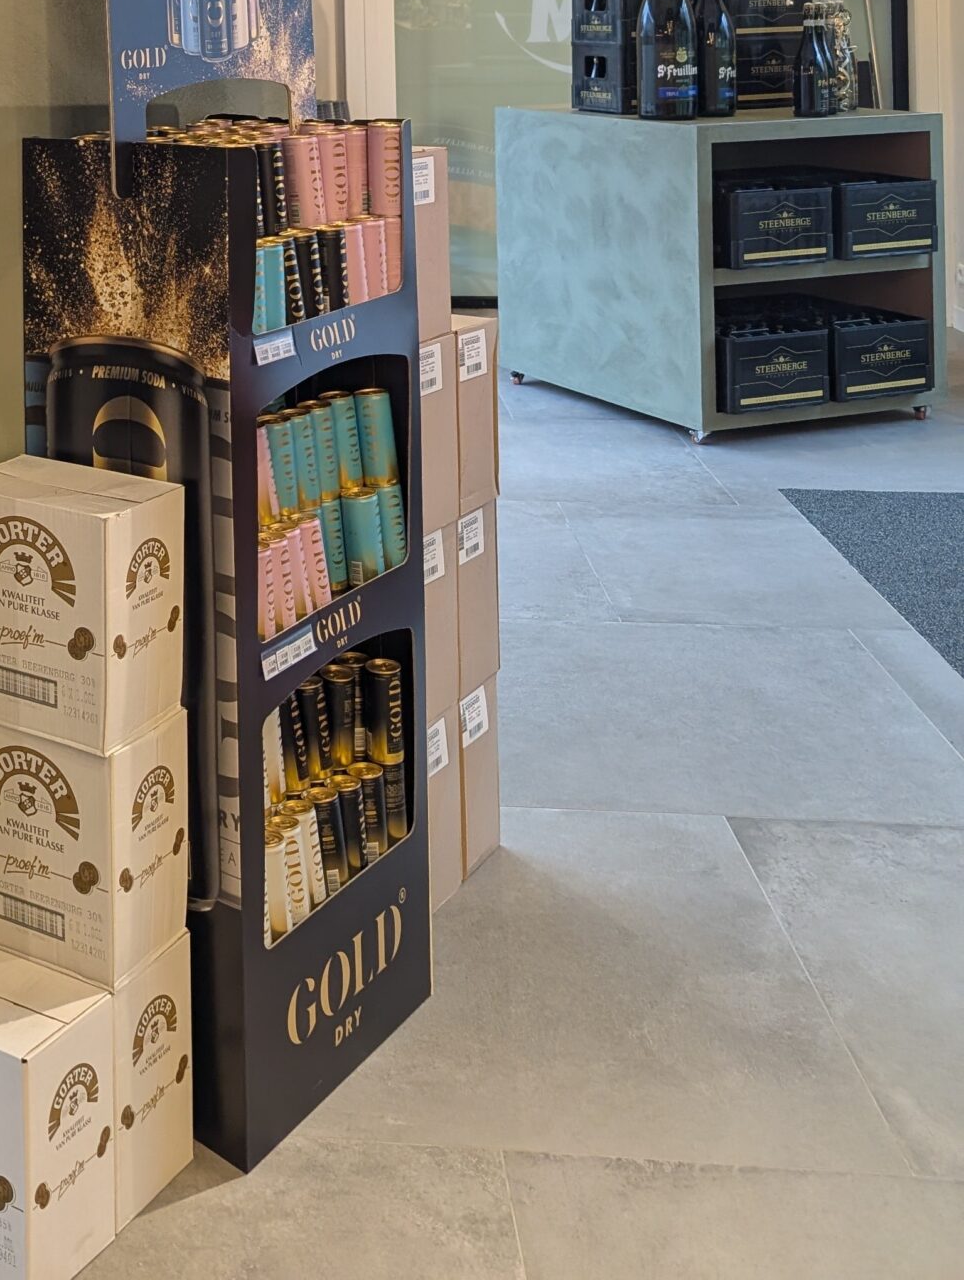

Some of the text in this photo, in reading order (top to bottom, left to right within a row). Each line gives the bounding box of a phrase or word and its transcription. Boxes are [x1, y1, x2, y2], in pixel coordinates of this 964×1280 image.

[121, 47, 167, 70] GOLD
[333, 142, 348, 206] GOLD
[384, 136, 400, 198] GOLD
[758, 216, 812, 229] STEENBERGE
[866, 208, 918, 221] STEENBERGE
[284, 249, 305, 318] GOLD
[310, 317, 357, 352] GOLD
[331, 349, 343, 360] DRY
[755, 360, 808, 375] STEENBERGE
[860, 348, 911, 363] STEENBERGE
[91, 365, 139, 382] PREMIUM
[141, 370, 166, 389] SODA
[331, 508, 345, 566] GOLD
[130, 541, 165, 573] GORTER
[311, 528, 329, 591] GOLD
[280, 548, 295, 612] GOLD
[1, 588, 46, 607] KWALITEIT
[7, 600, 29, 613] PURE
[31, 605, 61, 621] KLASSE
[315, 600, 362, 644] GOLD
[336, 635, 348, 649] DRY
[22, 659, 75, 681] BEERENBURG
[388, 680, 403, 738] GOLD
[136, 769, 171, 804] GORTER
[6, 817, 49, 838] KWALITEIT
[12, 829, 34, 843] PURE
[36, 837, 65, 853] KLASSE
[3, 854, 50, 879] proef'm
[285, 839, 305, 904] GOLD
[287, 904, 402, 1045] GOLD
[137, 998, 172, 1039] GORTER
[335, 1006, 363, 1047] DRY
[53, 1067, 93, 1111] GORTER
